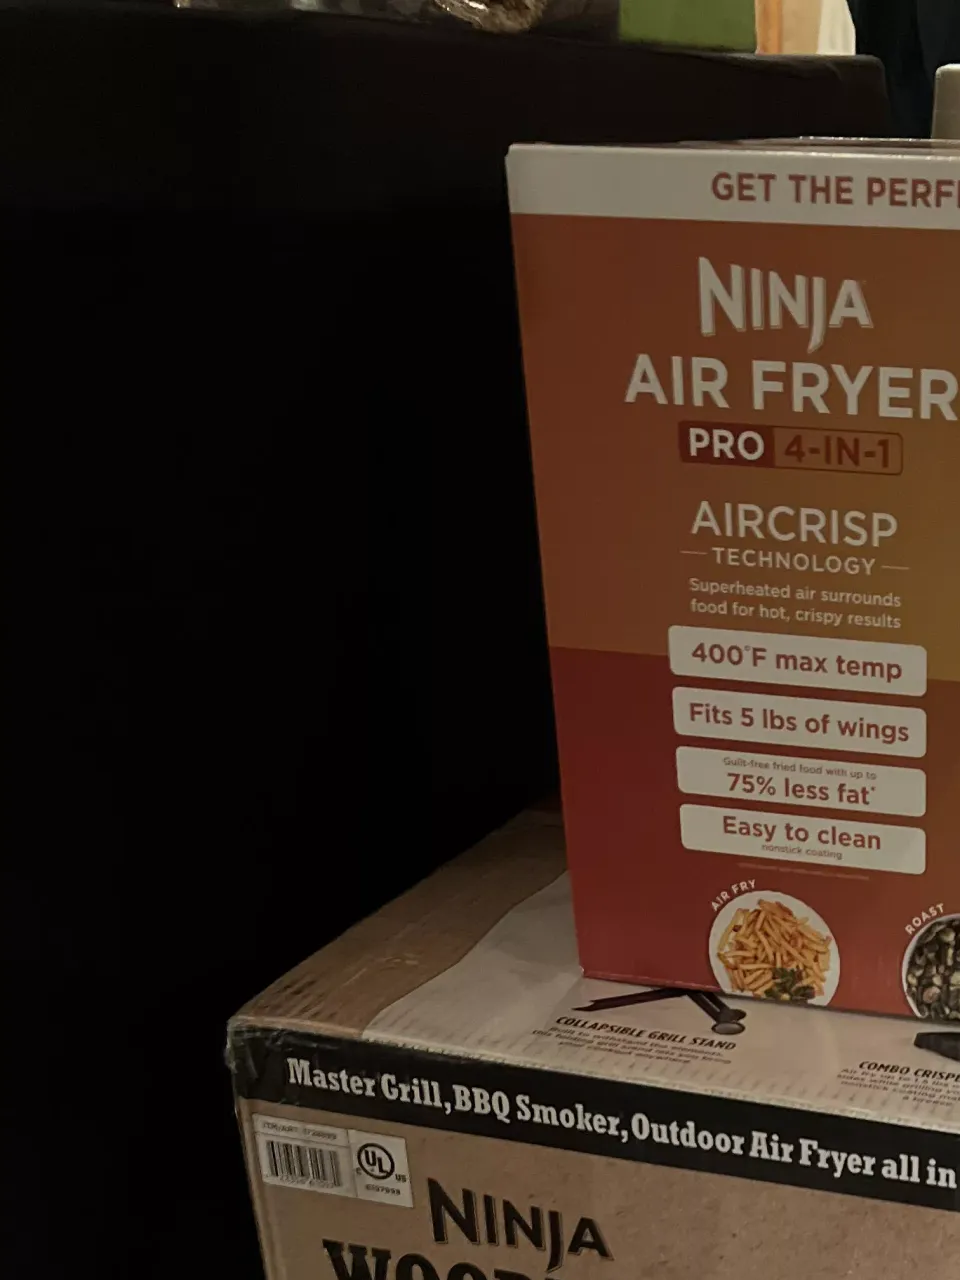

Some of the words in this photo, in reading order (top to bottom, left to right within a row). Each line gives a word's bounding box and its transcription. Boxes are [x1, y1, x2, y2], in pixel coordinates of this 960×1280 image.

[711, 172, 777, 203] GET
[788, 173, 853, 206] THE
[699, 256, 874, 353] NINJA
[624, 353, 730, 408] AIR
[752, 360, 959, 421] FRYER
[688, 428, 765, 461] PRO
[784, 437, 890, 468] 4-IN-1
[691, 501, 898, 547] AIRCRISP
[712, 548, 876, 576] TECHNOLOGY
[688, 578, 791, 599] Superheated
[796, 585, 816, 601] air
[821, 588, 901, 607] surrounds
[690, 598, 728, 615] food
[732, 602, 754, 617] for
[760, 604, 791, 622] hot,
[796, 608, 843, 627] crispy
[848, 613, 901, 629] results
[692, 642, 767, 667] 400°F
[776, 652, 828, 673] max
[836, 655, 902, 682] temp
[689, 703, 733, 726] Fits
[741, 708, 754, 727] 5
[763, 710, 797, 731] lbs
[805, 715, 830, 734] of
[837, 720, 909, 744] wings
[723, 756, 770, 770] Guilt-free
[772, 760, 796, 772] fried
[800, 763, 823, 774] food
[826, 766, 847, 777] with
[850, 770, 863, 781] up
[866, 771, 877, 781] to
[727, 773, 776, 796] 75%
[785, 778, 829, 800] less
[723, 815, 776, 842] Easy
[785, 823, 809, 842] to
[818, 827, 881, 850] clean
[761, 843, 803, 855] nonstick
[805, 847, 843, 860] coating
[711, 890, 731, 912] AIR
[731, 879, 757, 897] FRY
[905, 903, 946, 936] ROAST
[556, 1016, 648, 1038] COLLAPSIBLE
[648, 1031, 686, 1044] GRILL
[689, 1037, 737, 1050] STAND
[858, 1061, 910, 1075] COMBO
[287, 1057, 376, 1099] Master
[380, 1064, 451, 1115] Grill,
[453, 1085, 511, 1123] BBQ
[516, 1095, 629, 1145] Smoker,
[631, 1112, 745, 1157] Outdoor
[749, 1131, 794, 1164] Air
[799, 1139, 877, 1178] Fryer
[882, 1154, 921, 1183] all
[926, 1159, 957, 1189] in
[428, 1177, 615, 1273] NINJA
